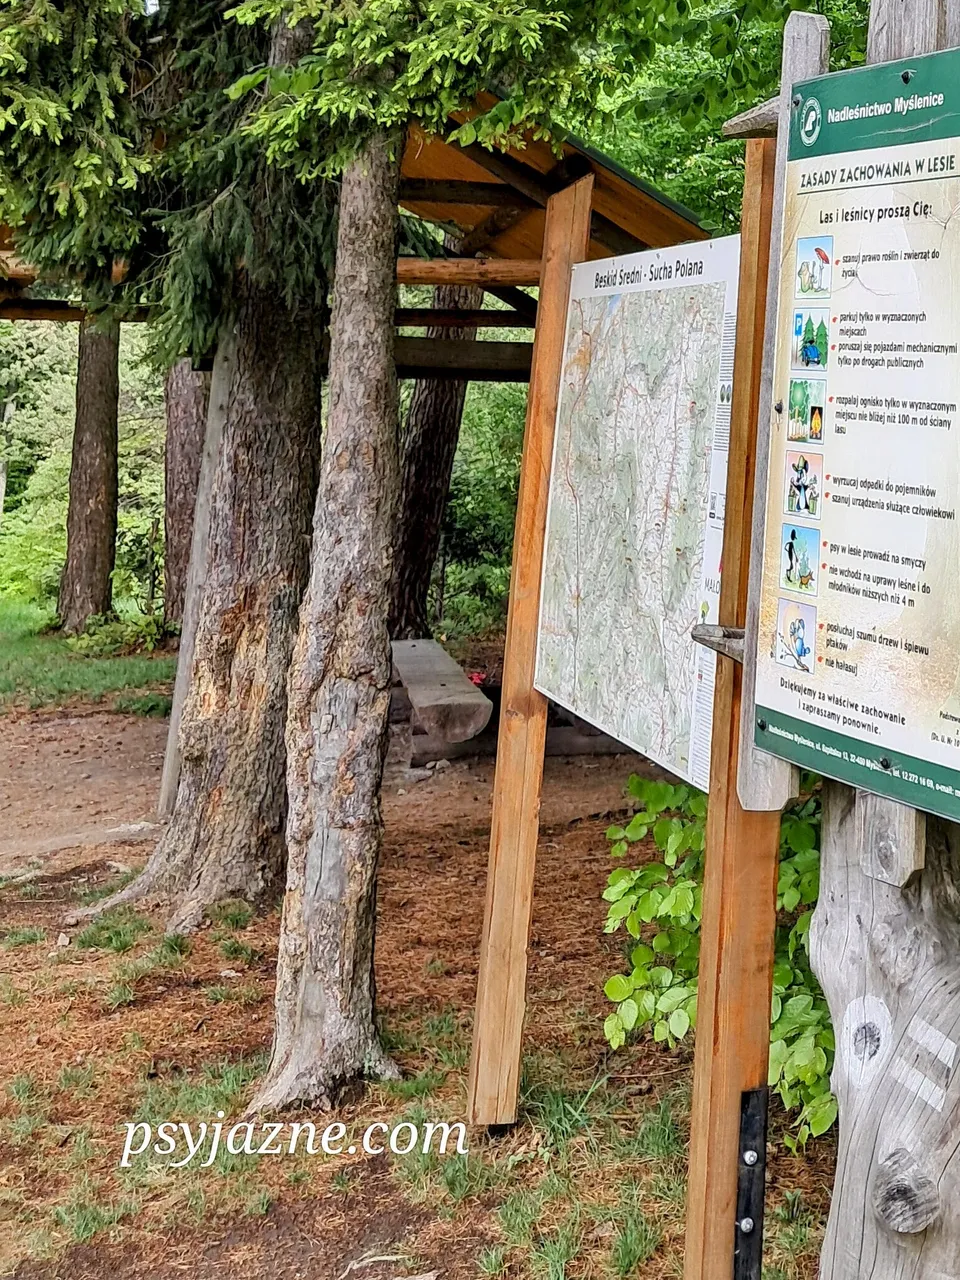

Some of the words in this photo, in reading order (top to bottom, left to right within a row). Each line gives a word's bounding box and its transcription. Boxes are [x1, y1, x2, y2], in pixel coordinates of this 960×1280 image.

[828, 101, 892, 124] Nadleśnictwo
[894, 93, 944, 115] Myślenice
[801, 169, 837, 188] ZASADY
[840, 160, 911, 183] ZACHOWANIA
[916, 160, 925, 173] W
[928, 155, 955, 173] LESIE
[820, 211, 833, 224] Las
[841, 205, 875, 223] leśnicy
[877, 202, 910, 220] proszą
[913, 201, 932, 216] Cię:
[842, 252, 860, 264] szanuj
[862, 254, 880, 265] prawo
[882, 251, 898, 261] roślin
[903, 250, 930, 261] zwierząt
[931, 248, 940, 259] do
[594, 268, 617, 289] Beskid
[618, 264, 642, 285] Średni
[648, 261, 672, 281] Sucha
[675, 258, 703, 278] Polana
[840, 312, 858, 323] parkuj
[859, 312, 873, 324] tylko
[882, 311, 926, 323] wyznaczonych
[839, 326, 867, 338] miejscach
[838, 341, 862, 353] poruszaj
[863, 341, 872, 353] się
[873, 342, 905, 353] pojazdami
[906, 342, 958, 355] mechanicznymi
[838, 356, 852, 367] tylko
[852, 357, 860, 368] po
[861, 356, 885, 368] drogach
[886, 357, 924, 370] publicznych
[835, 395, 858, 408] rozpalaj
[860, 397, 883, 408] ognisko
[884, 398, 900, 410] tylko
[909, 401, 957, 414] wyznaczonym
[834, 424, 846, 434] lasu
[835, 409, 857, 421] miejscu
[858, 410, 867, 421] nie
[868, 411, 885, 424] bliżej
[887, 412, 896, 423] niż
[898, 414, 910, 424] 100
[911, 417, 918, 425] m
[919, 415, 928, 426] od
[929, 415, 952, 430] ściany
[832, 476, 858, 489] wyrzucaj
[859, 478, 884, 491] odpadki
[885, 480, 893, 492] do
[895, 483, 936, 497] pojemników
[831, 494, 850, 507] szanuj
[851, 496, 884, 510] urządzenia
[886, 500, 910, 515] służące
[911, 504, 955, 520] człowiekowi
[830, 543, 840, 555] psy
[847, 544, 861, 556] lesie
[862, 549, 890, 562] prowadź
[891, 554, 899, 564] na
[901, 556, 926, 571] smyczy
[828, 564, 838, 575] nie
[839, 567, 861, 580] wchodź
[862, 572, 871, 582] na
[872, 574, 897, 590] uprawy
[897, 577, 916, 591] leśne
[921, 582, 931, 594] do
[828, 580, 860, 596] młodników
[861, 587, 889, 603] niższych
[890, 593, 900, 604] niż
[901, 595, 907, 606] 4
[907, 597, 915, 608] m
[826, 623, 855, 639] posłuchaj
[856, 630, 877, 643] szumu
[878, 634, 899, 649] drzew
[903, 638, 929, 655] śpiewu
[826, 637, 849, 652] ptaków
[825, 657, 834, 668] nie
[835, 658, 858, 677] hałasuj
[780, 677, 817, 700] Dziękujemy
[818, 691, 826, 701] za
[827, 692, 859, 712] właściwe
[861, 704, 906, 725] zachowanie
[802, 702, 841, 724] zapraszamy
[842, 715, 881, 735] ponownie.
